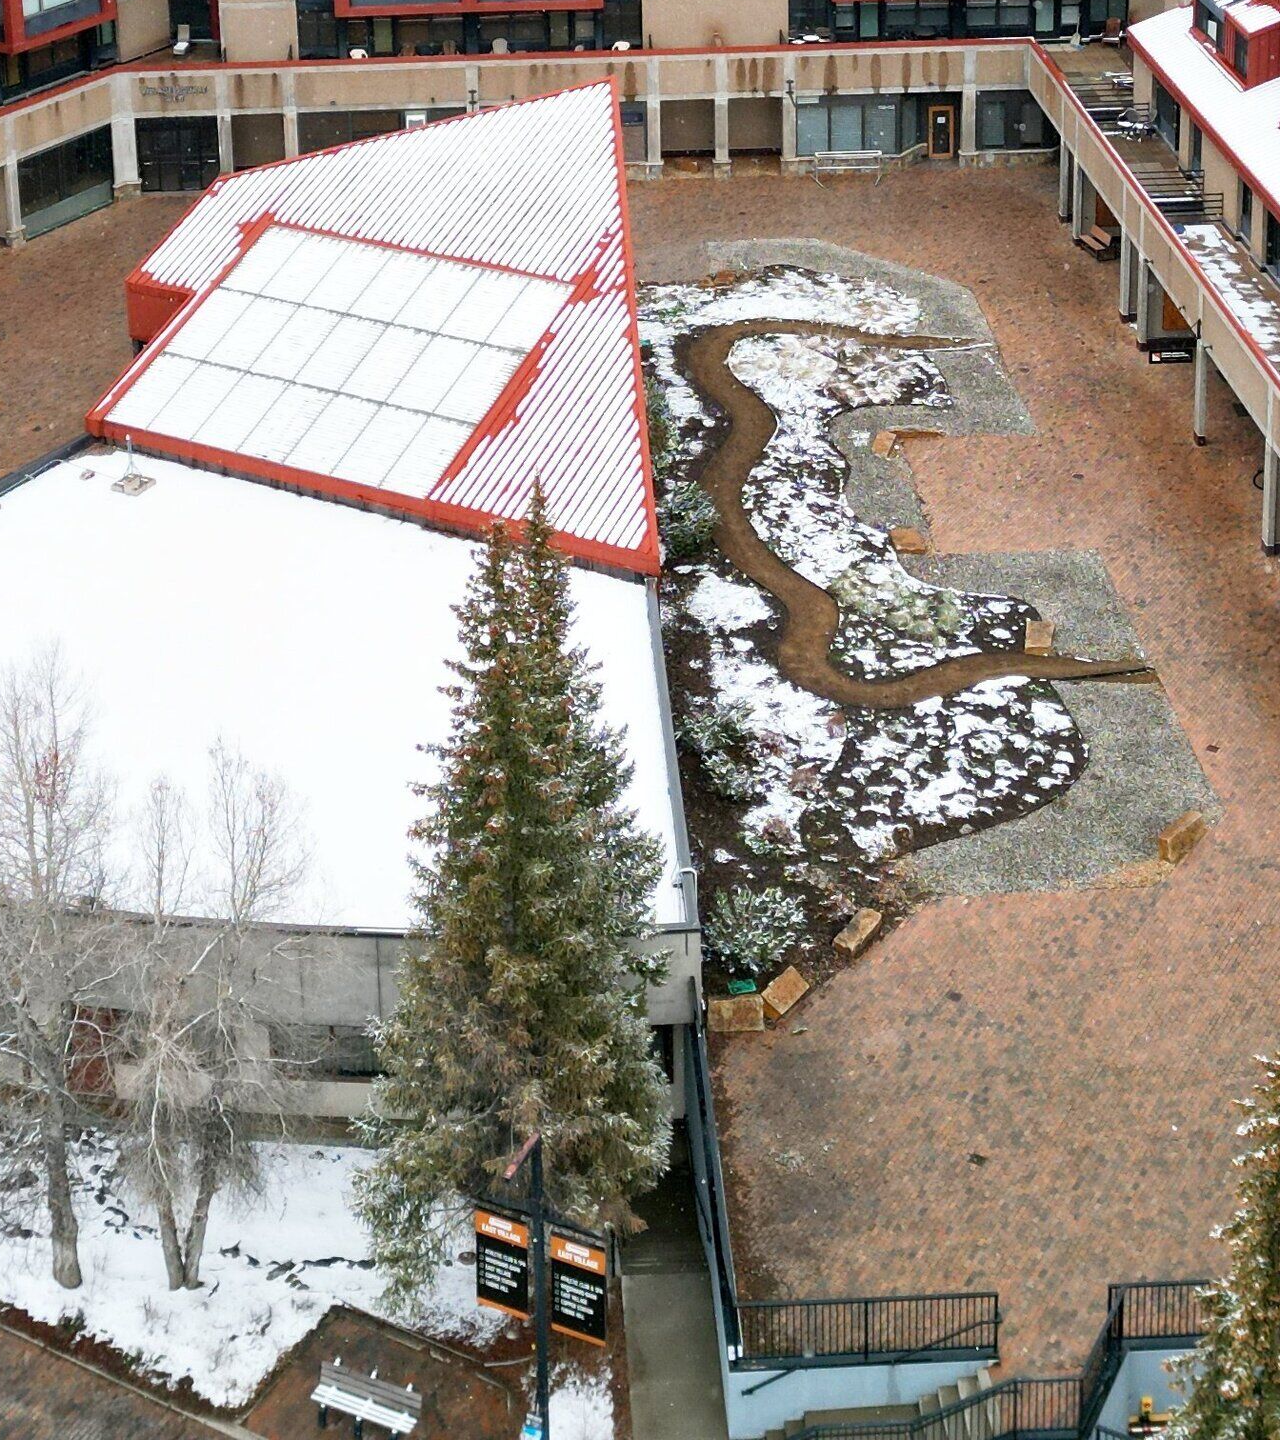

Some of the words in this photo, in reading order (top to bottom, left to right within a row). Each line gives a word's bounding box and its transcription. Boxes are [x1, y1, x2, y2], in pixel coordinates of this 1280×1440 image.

[481, 1223, 496, 1235] EAST
[497, 1228, 521, 1244] VILLAGE
[557, 1249, 573, 1262] EAST
[573, 1254, 599, 1270] VILLAGE
